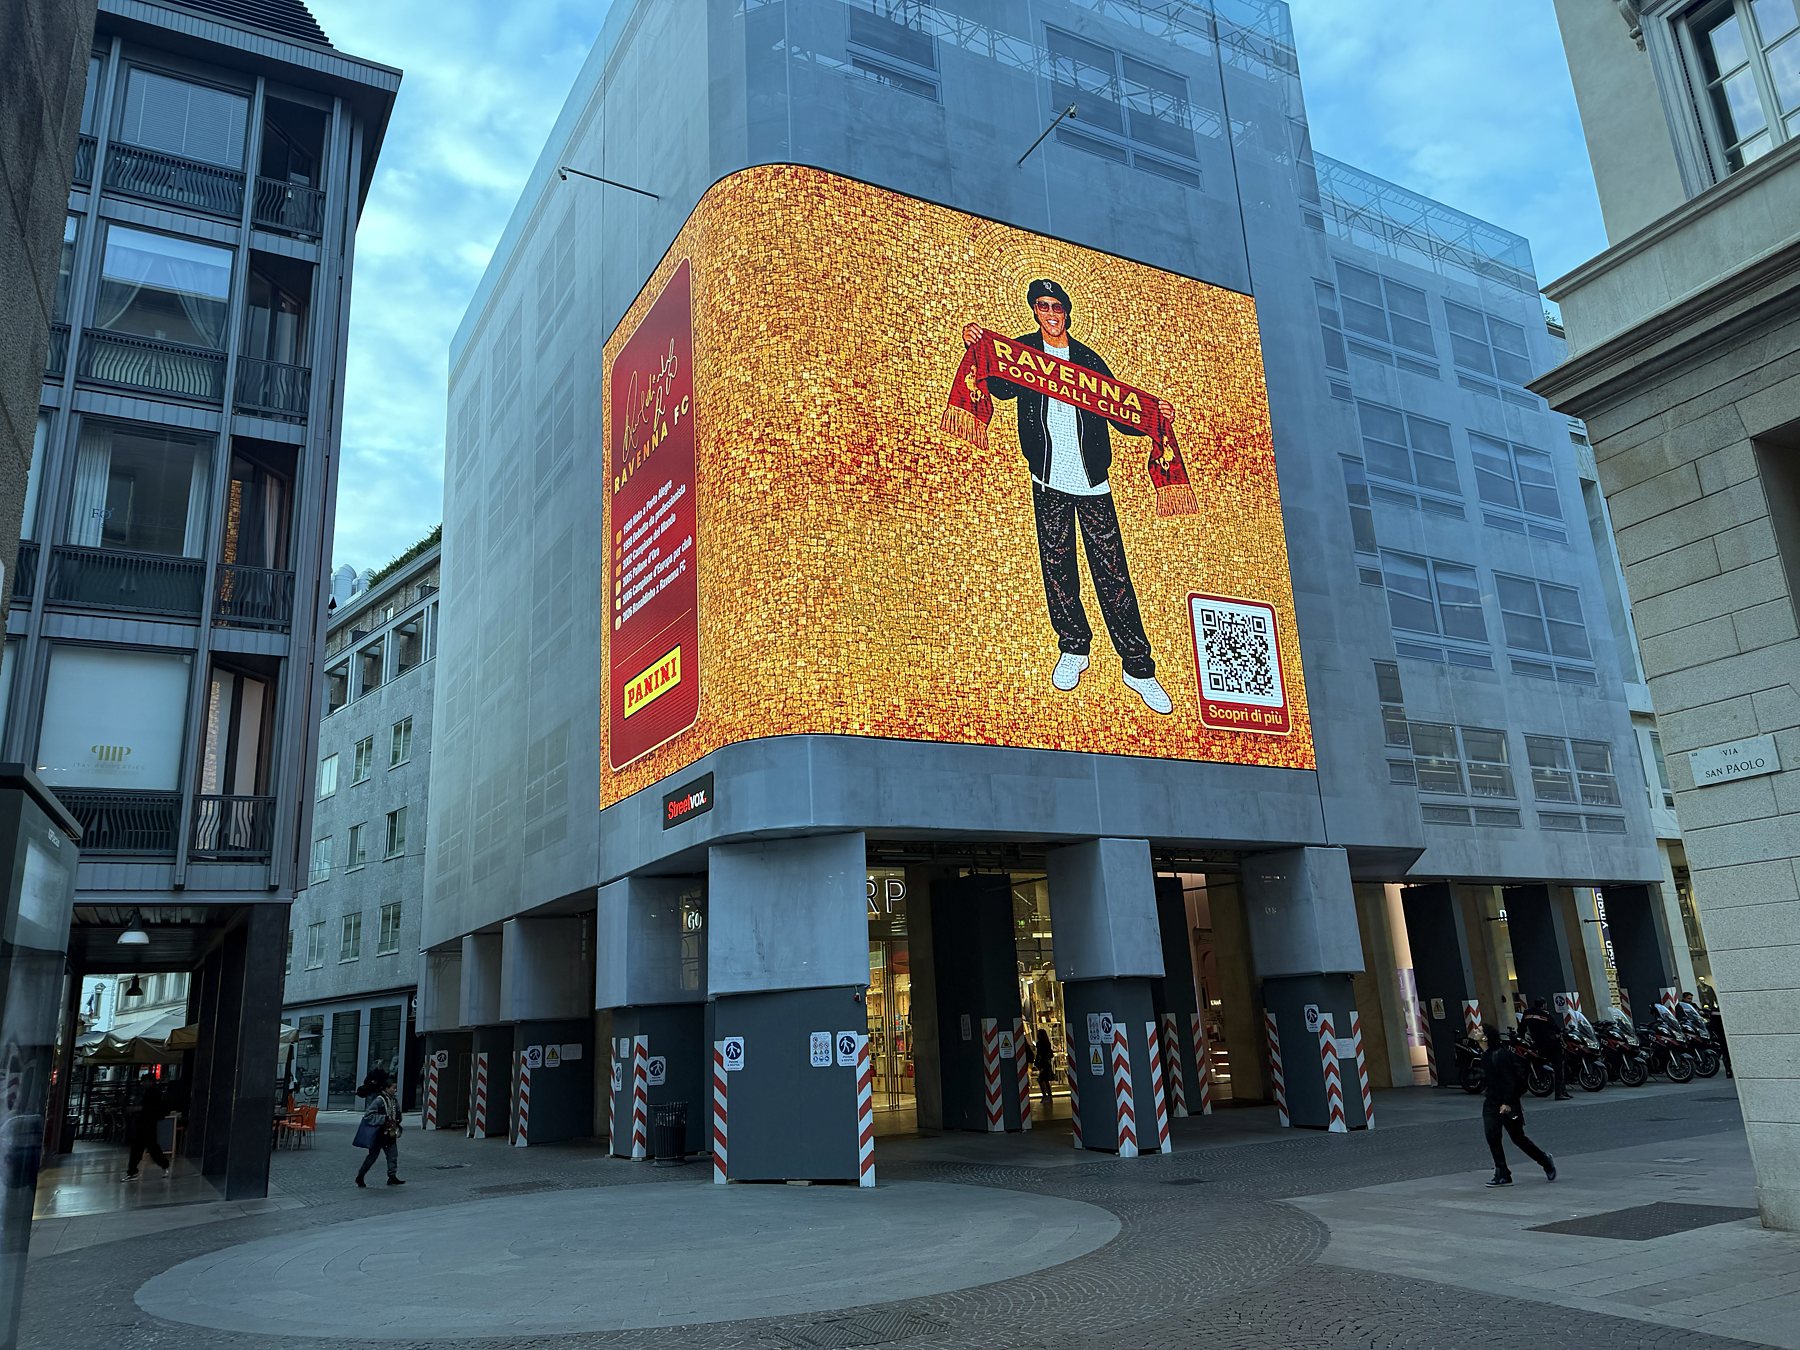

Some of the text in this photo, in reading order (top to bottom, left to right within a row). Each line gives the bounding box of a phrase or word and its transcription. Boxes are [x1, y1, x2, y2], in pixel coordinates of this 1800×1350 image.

[993, 338, 1143, 412] RAVENNA
[998, 362, 1142, 425] FOOTBALL CLUB
[613, 394, 690, 495] RAVENNA FC
[654, 484, 687, 524] professionista
[657, 479, 673, 501] Alegre
[622, 512, 676, 571] 2002 Campione del Mondo
[632, 571, 653, 596] Campione
[653, 553, 673, 578] d'Europa
[672, 545, 681, 563] per
[681, 534, 694, 553] club
[632, 558, 648, 579] Pallone
[632, 588, 656, 615] Ronaldinho
[659, 567, 680, 591] Ravenna
[679, 559, 687, 574] FC
[627, 656, 677, 709] PANINI
[1208, 704, 1283, 727] Scopri di più
[1705, 758, 1765, 778] SAN PAOLO
[1722, 748, 1739, 757] VIA
[866, 879, 907, 914] RP
